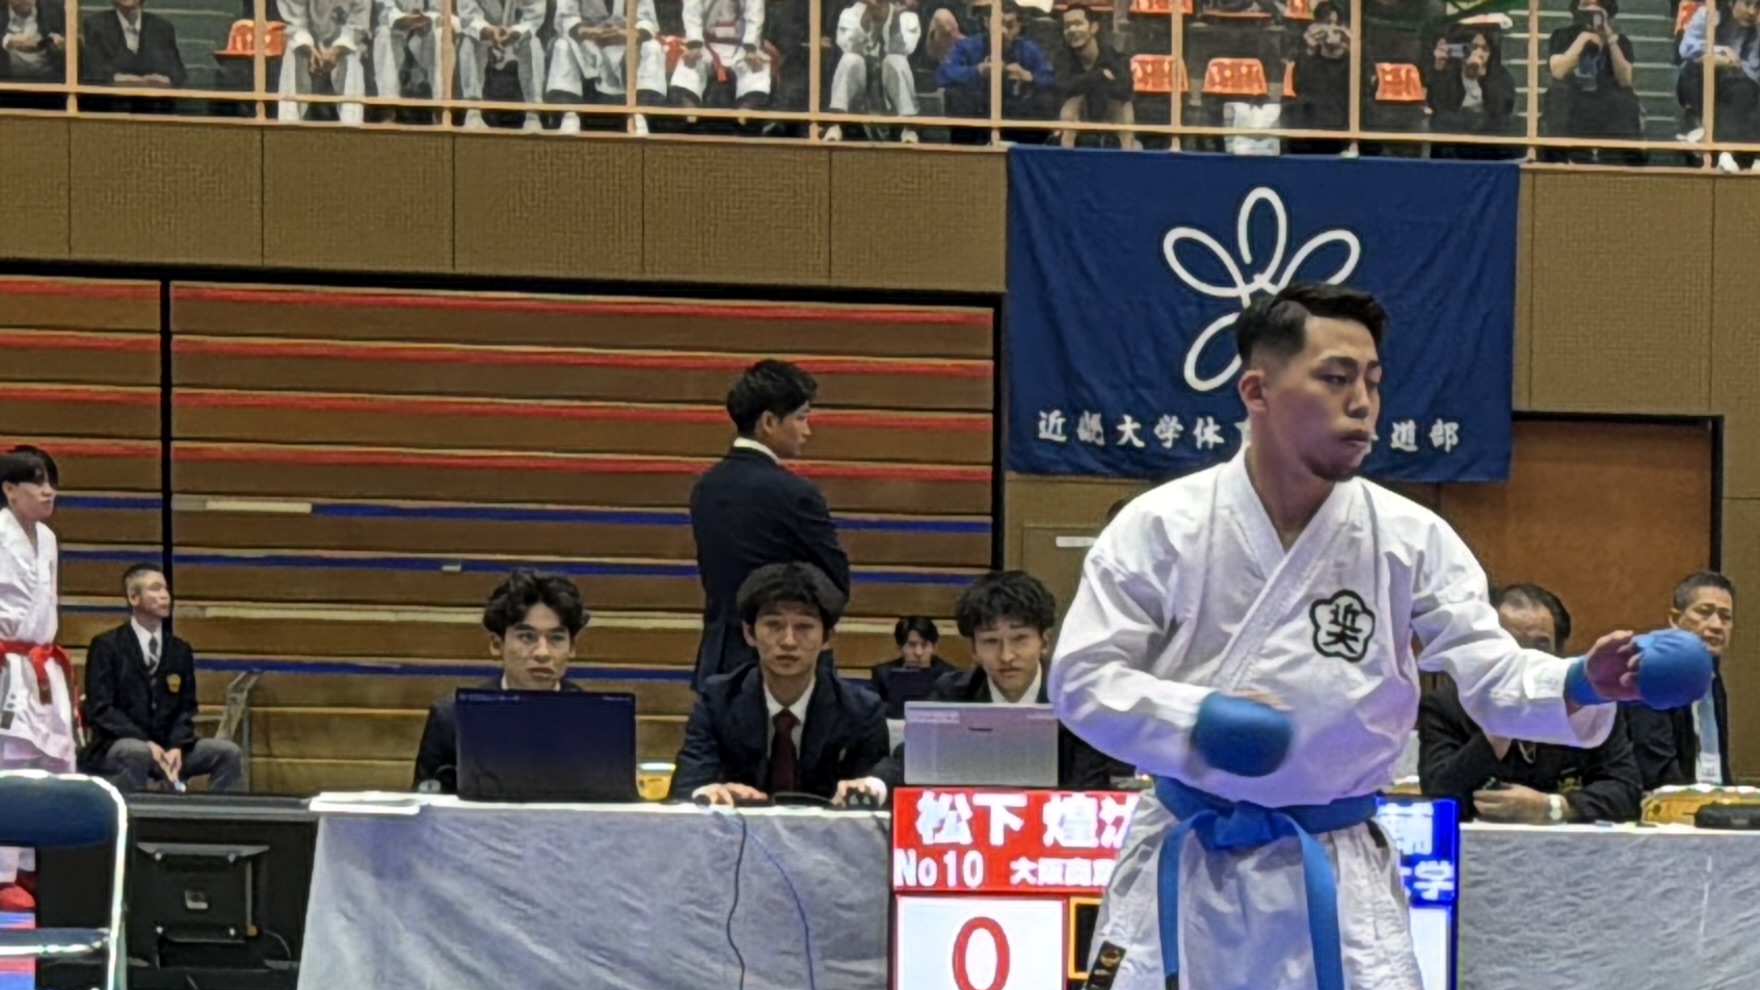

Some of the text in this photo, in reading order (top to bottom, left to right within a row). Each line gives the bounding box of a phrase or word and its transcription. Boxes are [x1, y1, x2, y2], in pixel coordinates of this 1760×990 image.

[1322, 603, 1363, 654] 近大
[915, 790, 1028, 846] 松下
[893, 848, 984, 888] No10
